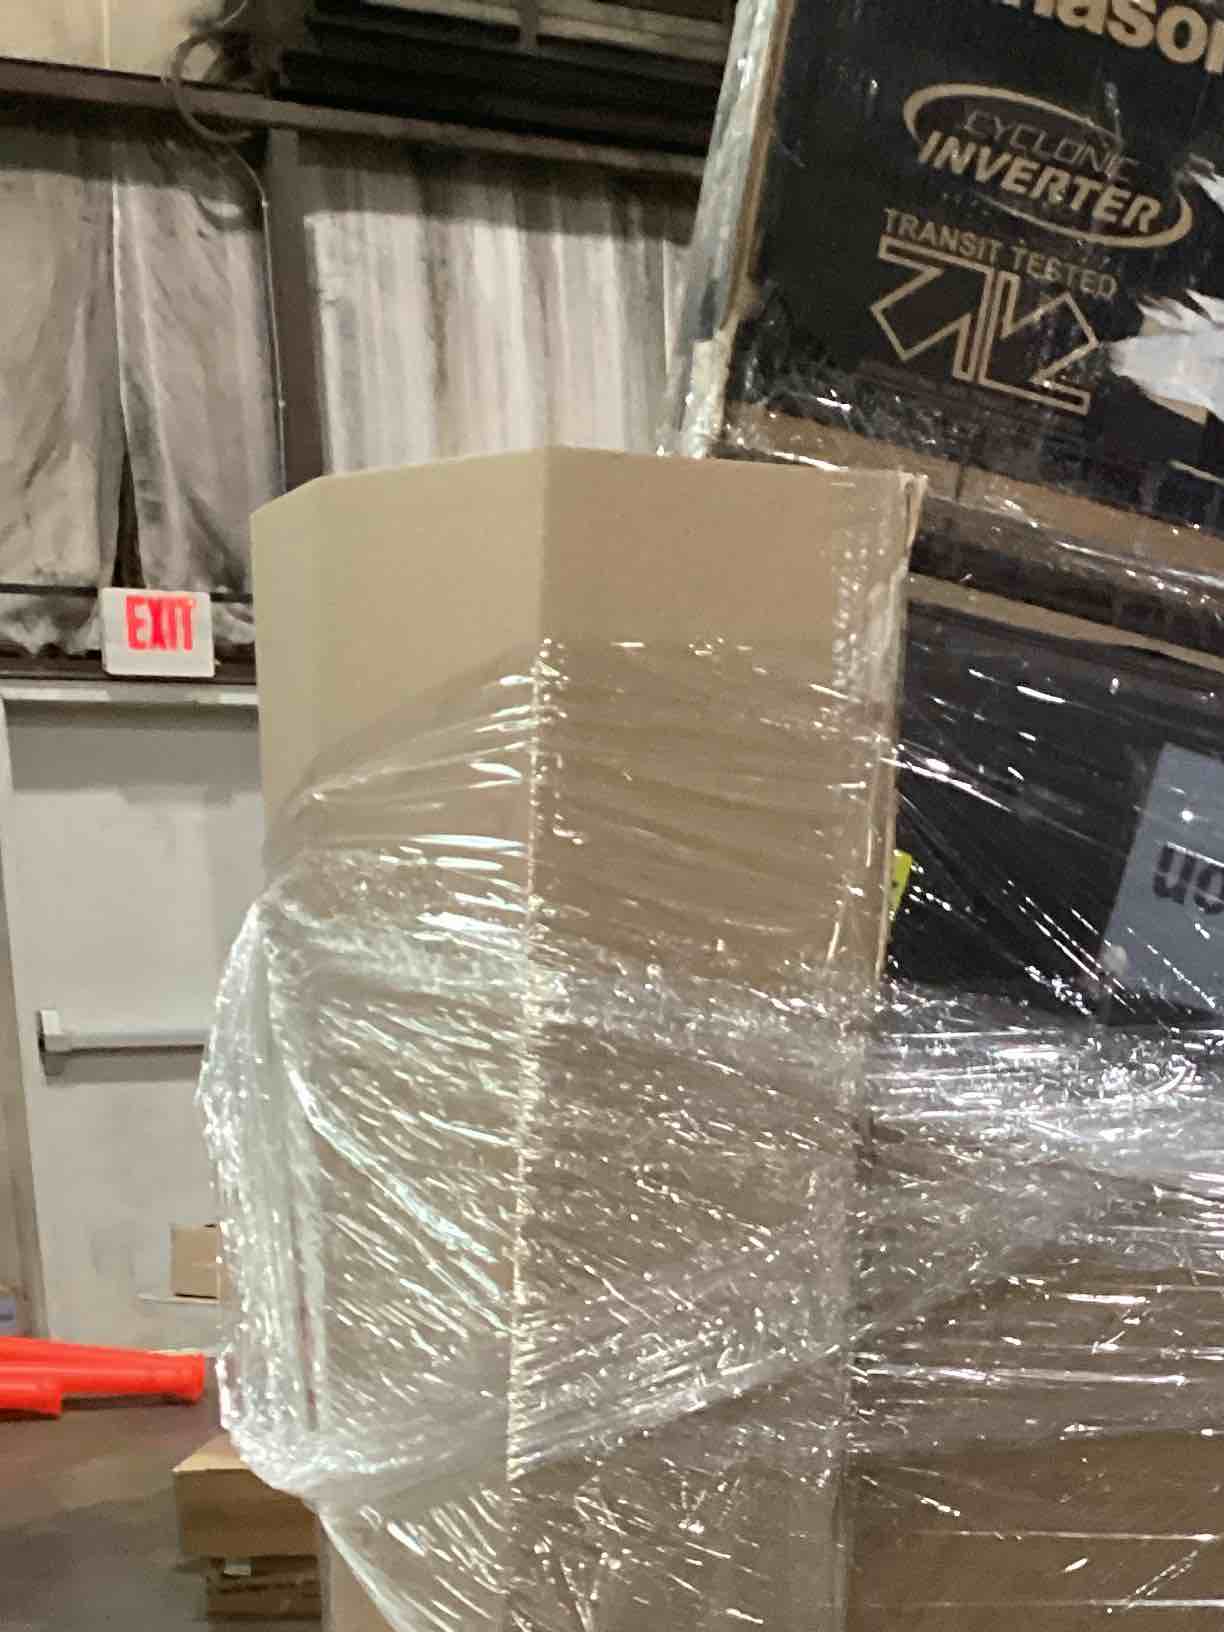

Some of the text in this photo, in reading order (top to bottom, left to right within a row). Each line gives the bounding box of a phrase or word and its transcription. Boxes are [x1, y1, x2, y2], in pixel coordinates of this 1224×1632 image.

[917, 129, 1162, 234] INVERTER
[963, 108, 1140, 183] CYCLONIC
[883, 207, 1119, 301] TRANSIT TESTED
[125, 595, 196, 653] EXIT
